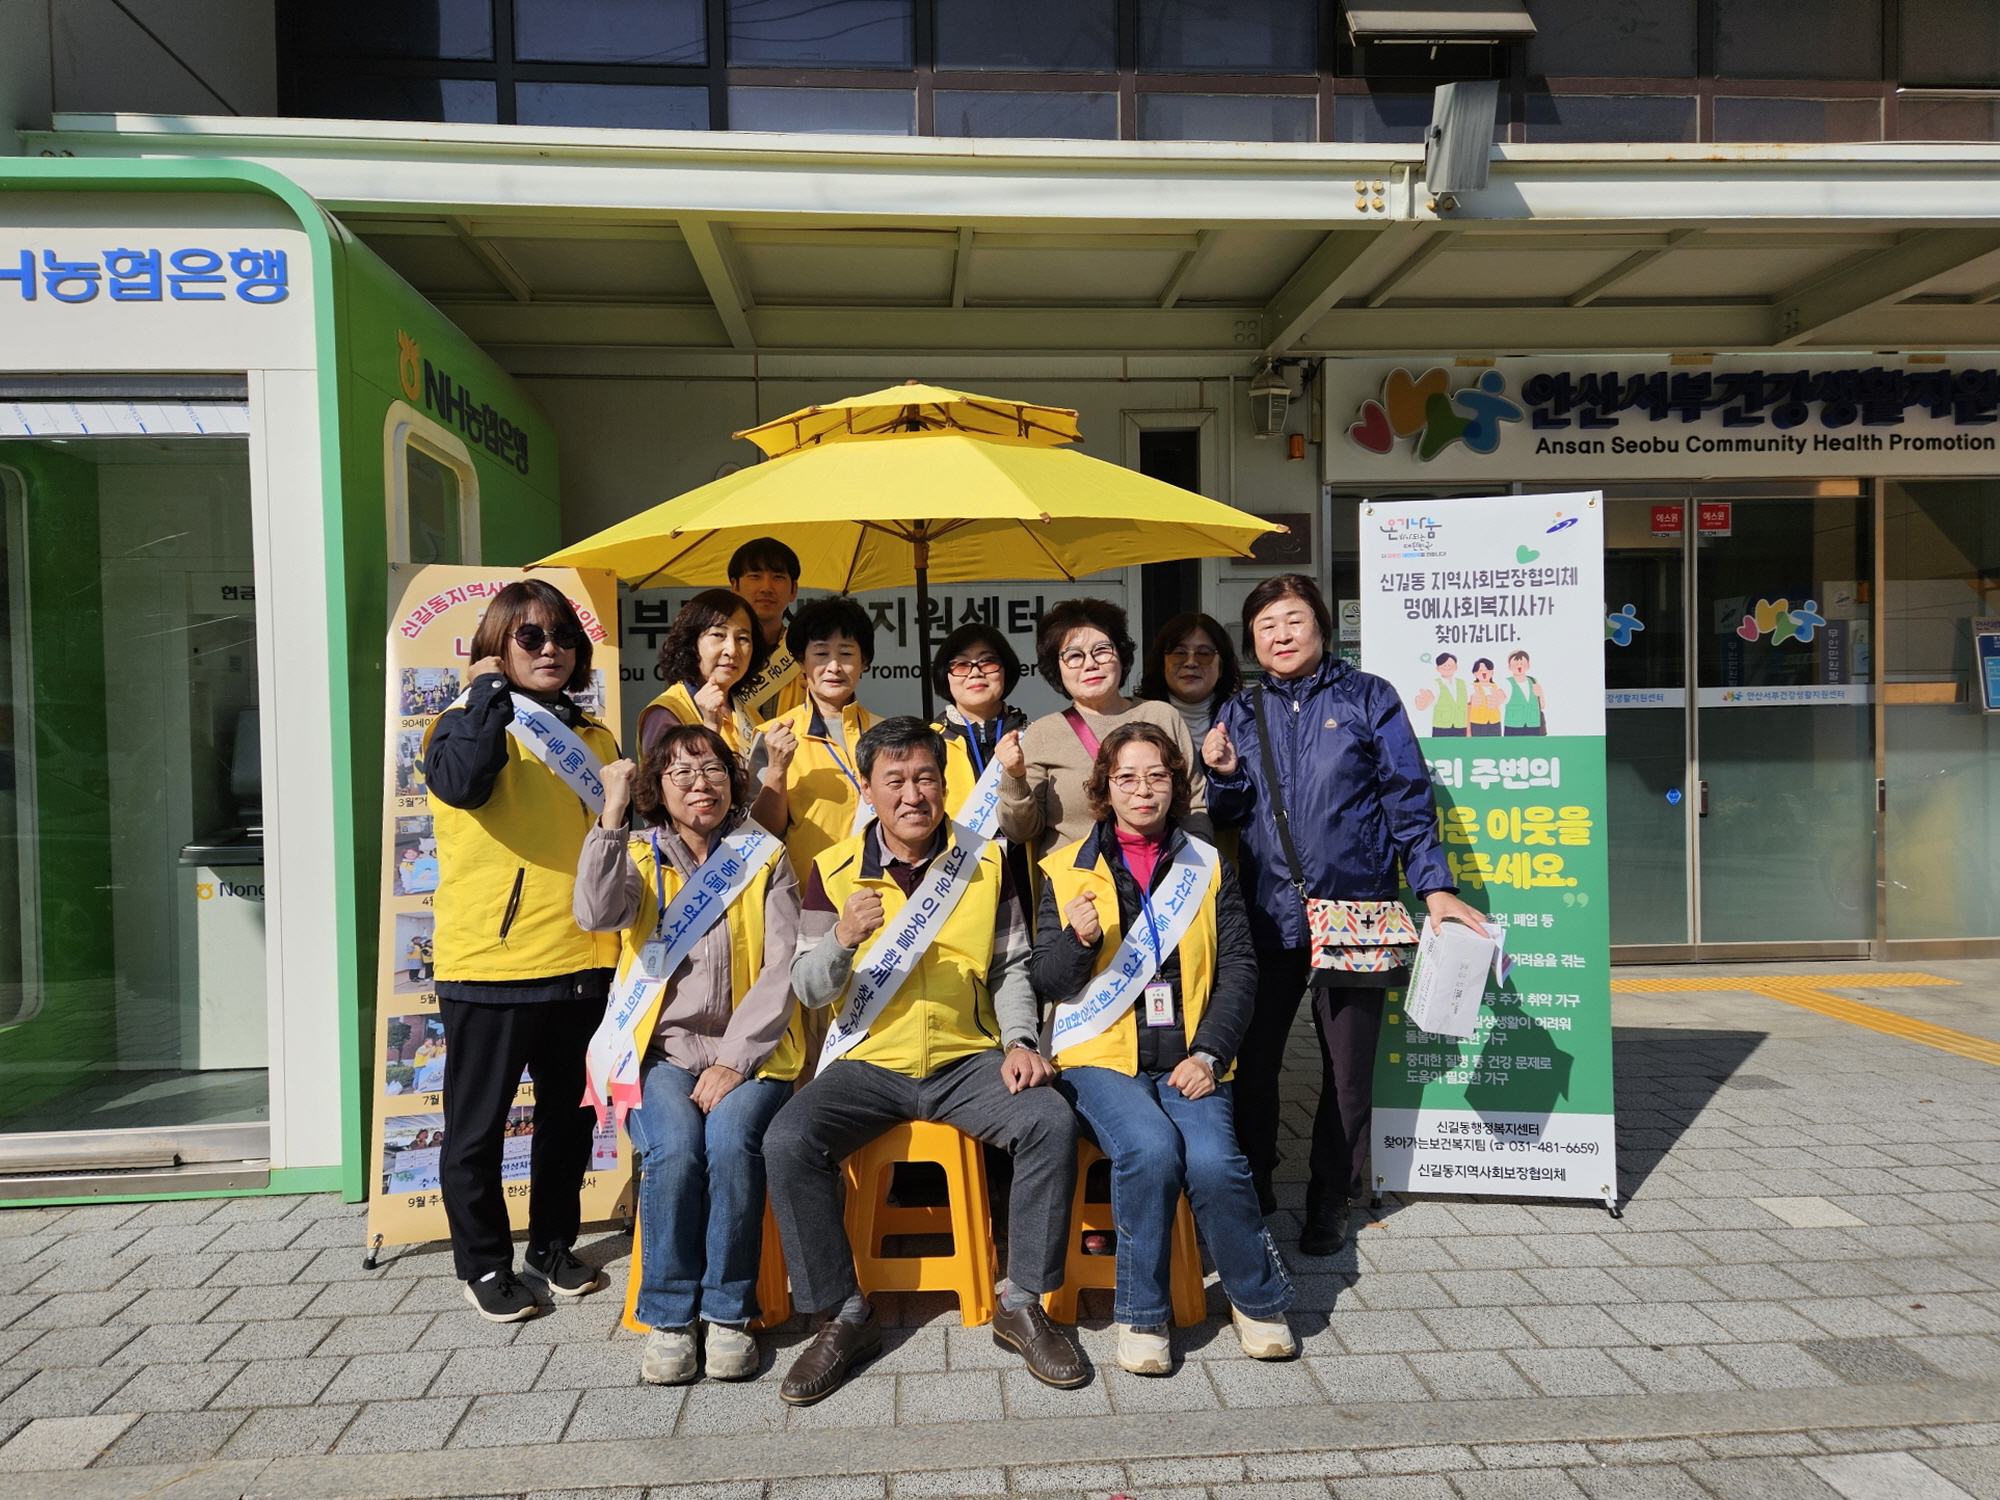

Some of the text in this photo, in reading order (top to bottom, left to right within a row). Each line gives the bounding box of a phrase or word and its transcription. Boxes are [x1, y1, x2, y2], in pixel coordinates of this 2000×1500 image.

[423, 358, 529, 475] NH농협은행
[1535, 433, 1996, 455] Ansan Seobu Community Health Promotion
[1380, 566, 1578, 592] 신길동 지역사회보장협의체
[1404, 594, 1555, 619] 명예사회복지사가
[1435, 623, 1522, 644] 찾아갑니다.
[1747, 690, 1845, 701] 안산서부건강생활지원센터
[1470, 757, 1560, 790] 주변의
[1487, 806, 1593, 846] 이웃을
[934, 845, 968, 898] 어려운
[1165, 867, 1198, 916] 안산시
[899, 897, 940, 950] 이웃을
[1513, 914, 1538, 927] 폐업
[1541, 914, 1554, 928] 등
[868, 948, 902, 988] 함께
[1509, 953, 1586, 968] 어려움을 겪는
[1484, 992, 1581, 1008] 등 주거 취약 가구
[1534, 1017, 1572, 1031] 어려워
[1484, 1032, 1508, 1046] 가구
[1406, 1053, 1552, 1070] 중대한 질병 등 건강 문제로
[1406, 1070, 1509, 1086] 도움이 필요한 가구
[1436, 1121, 1540, 1136] 신길동행정복지센터
[1384, 1136, 1486, 1152] 찾아가는보건복지팀
[1509, 1141, 1600, 1155] 031-481-6659)
[1417, 1163, 1566, 1182] 신길동지역사회보장협의체
[408, 1194, 426, 1208] 9월
